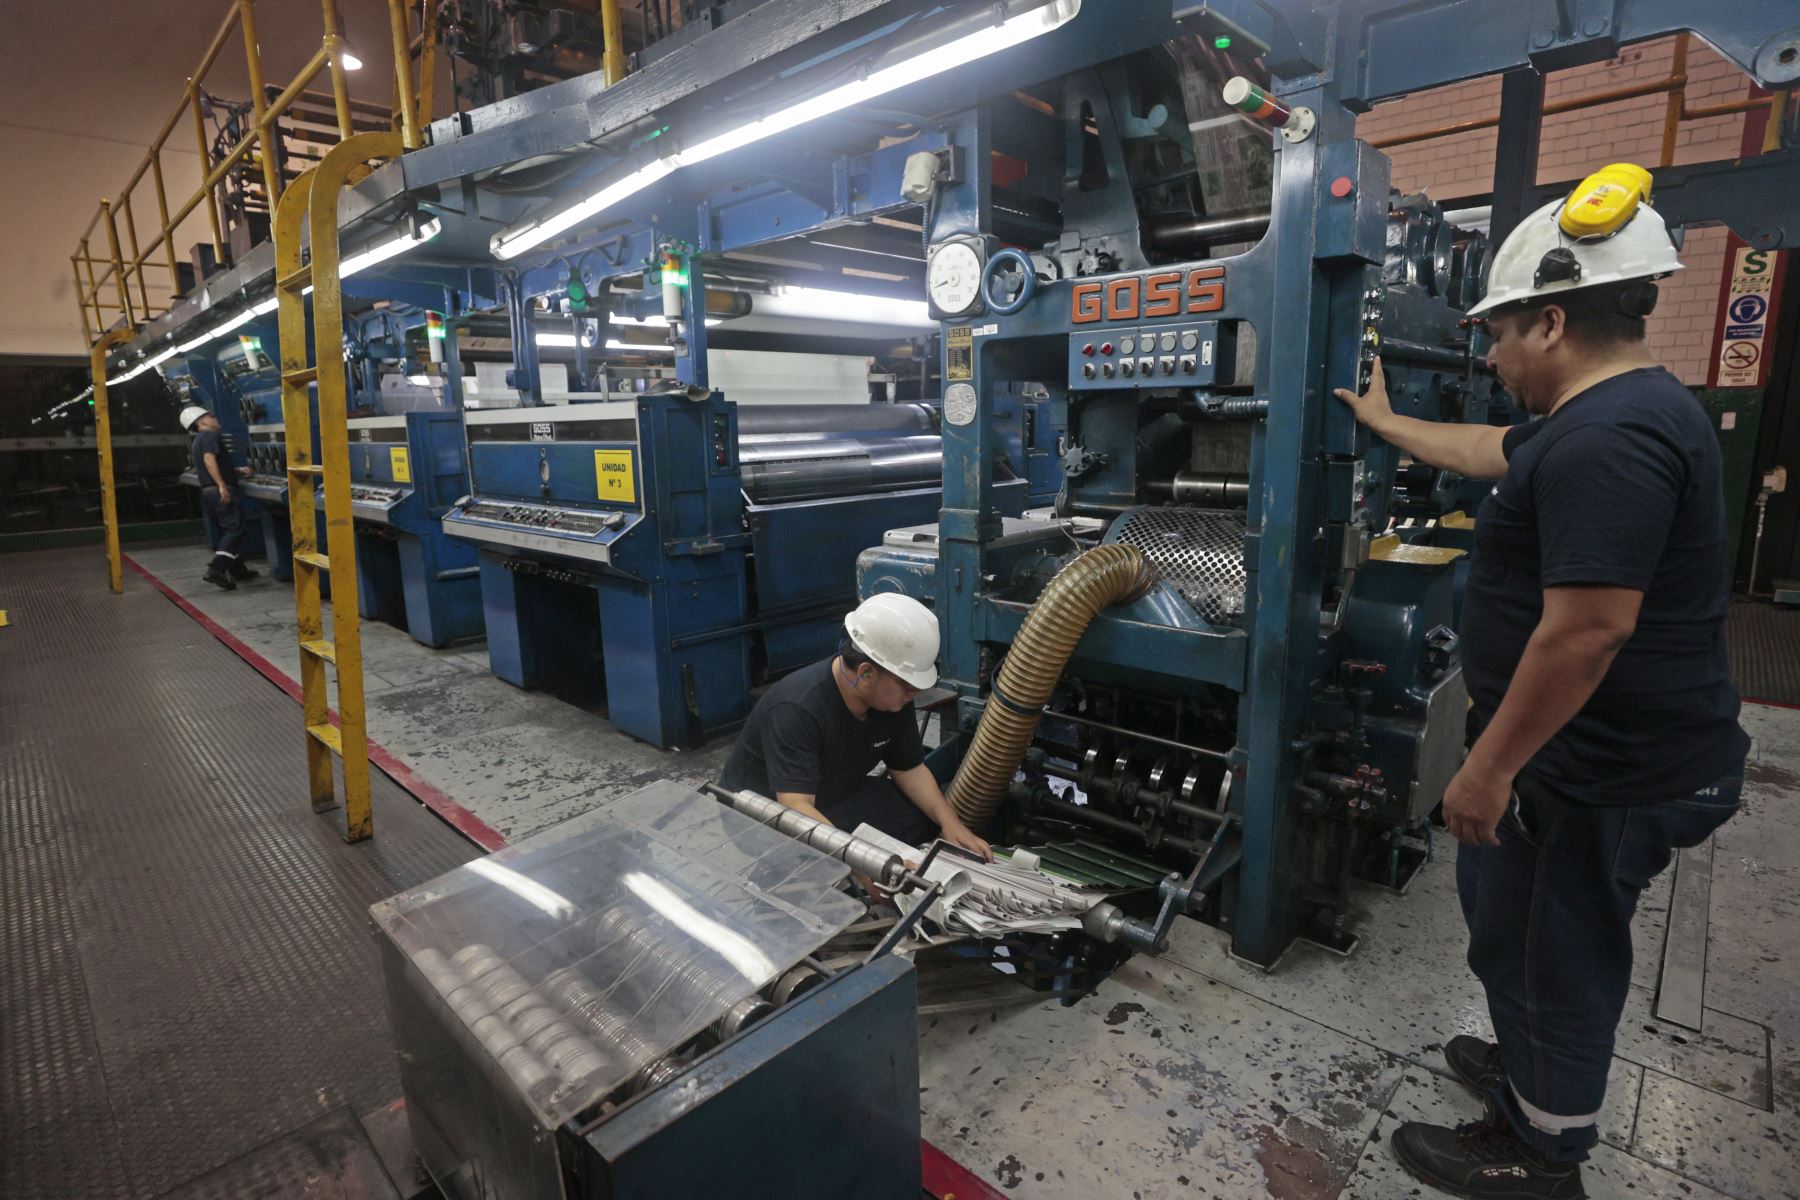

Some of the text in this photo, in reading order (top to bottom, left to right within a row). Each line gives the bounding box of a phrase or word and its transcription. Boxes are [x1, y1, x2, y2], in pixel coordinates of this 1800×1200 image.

[1743, 250, 1768, 275] S
[1072, 266, 1225, 324] GOSS
[533, 423, 551, 433] GOSS
[601, 463, 627, 473] UNIDAD
[617, 479, 622, 488] 3
